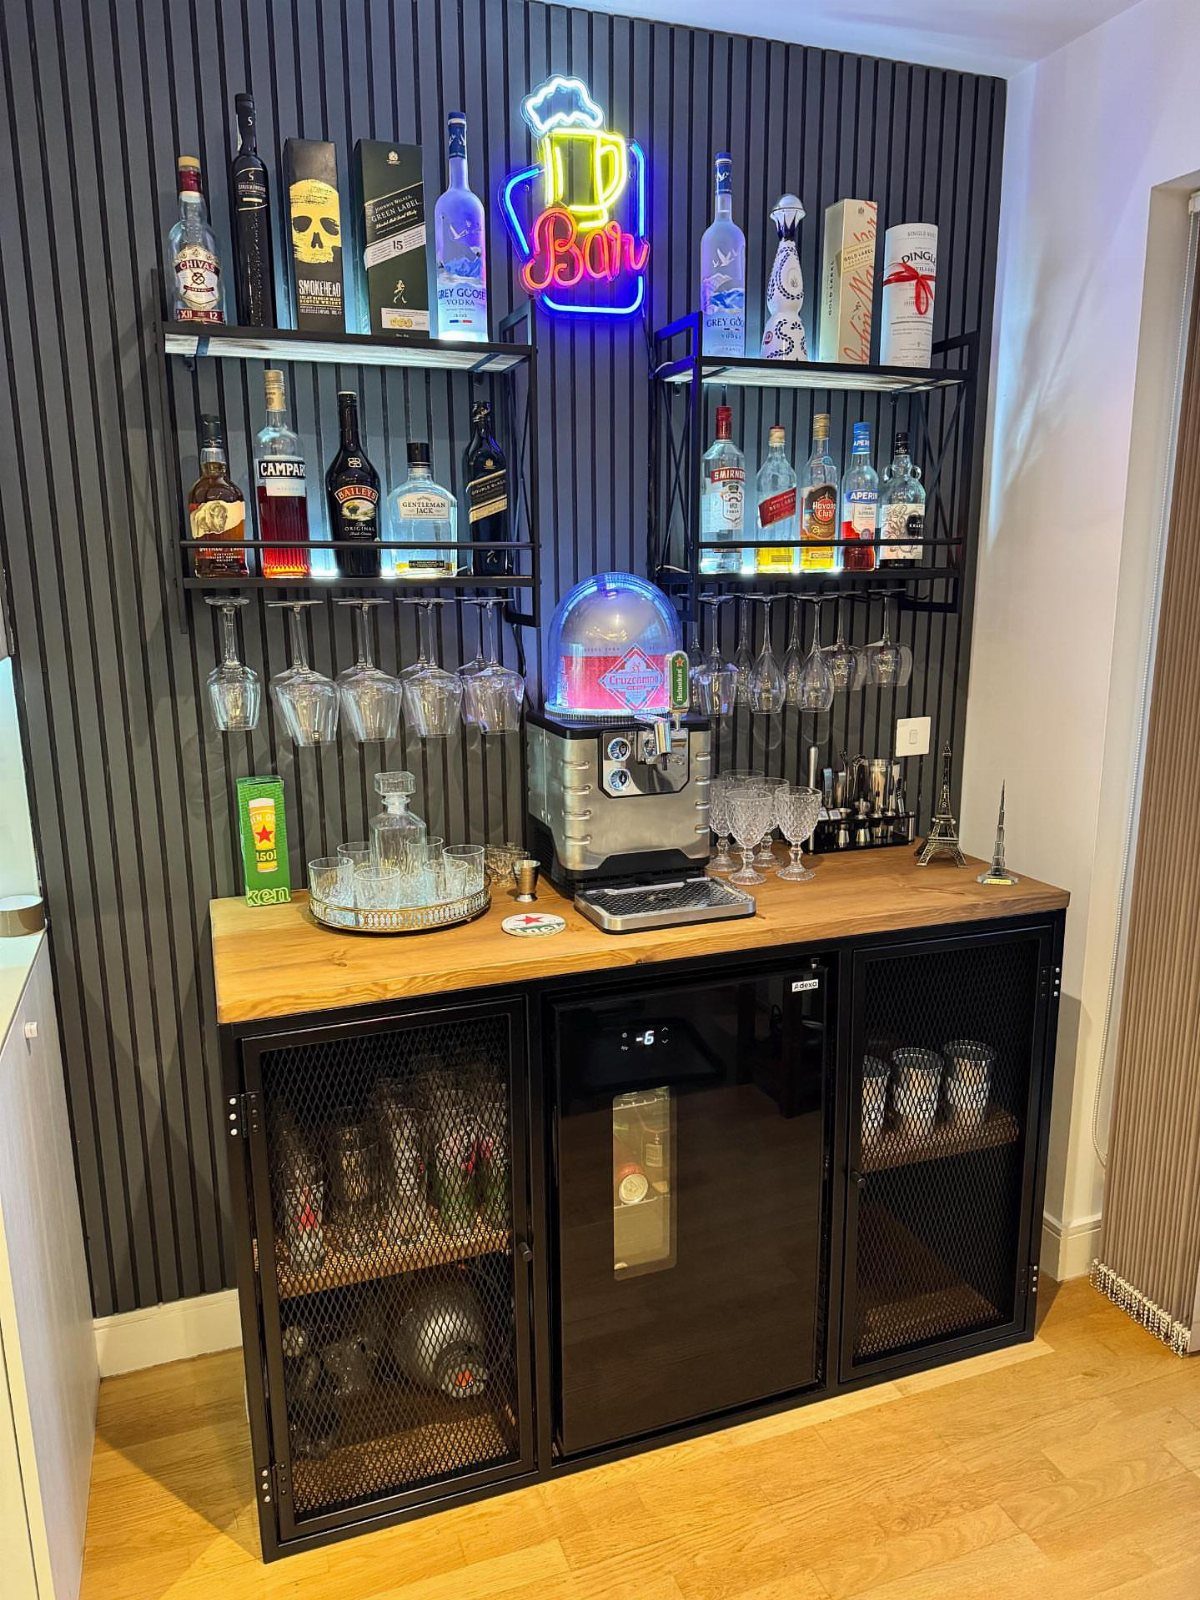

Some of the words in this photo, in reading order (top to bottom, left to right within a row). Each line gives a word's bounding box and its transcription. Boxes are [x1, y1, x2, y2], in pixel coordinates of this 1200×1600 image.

[248, 116, 253, 126] S
[371, 207, 396, 222] GREEN
[397, 199, 420, 212] LABEL
[392, 240, 404, 251] 15
[523, 207, 649, 290] Bar
[180, 260, 215, 272] CHIVAS
[299, 279, 341, 298] SMOKEHEAD
[456, 287, 486, 300] GOOSE
[181, 310, 192, 319] XII
[209, 311, 218, 320] 12
[706, 317, 727, 328] GREY
[338, 486, 377, 500] BAILEYS
[416, 507, 434, 515] JACK
[818, 510, 833, 518] Club
[609, 674, 660, 685] Cruzcampo
[793, 980, 818, 991] Adexa
[635, 1030, 655, 1045] -6
